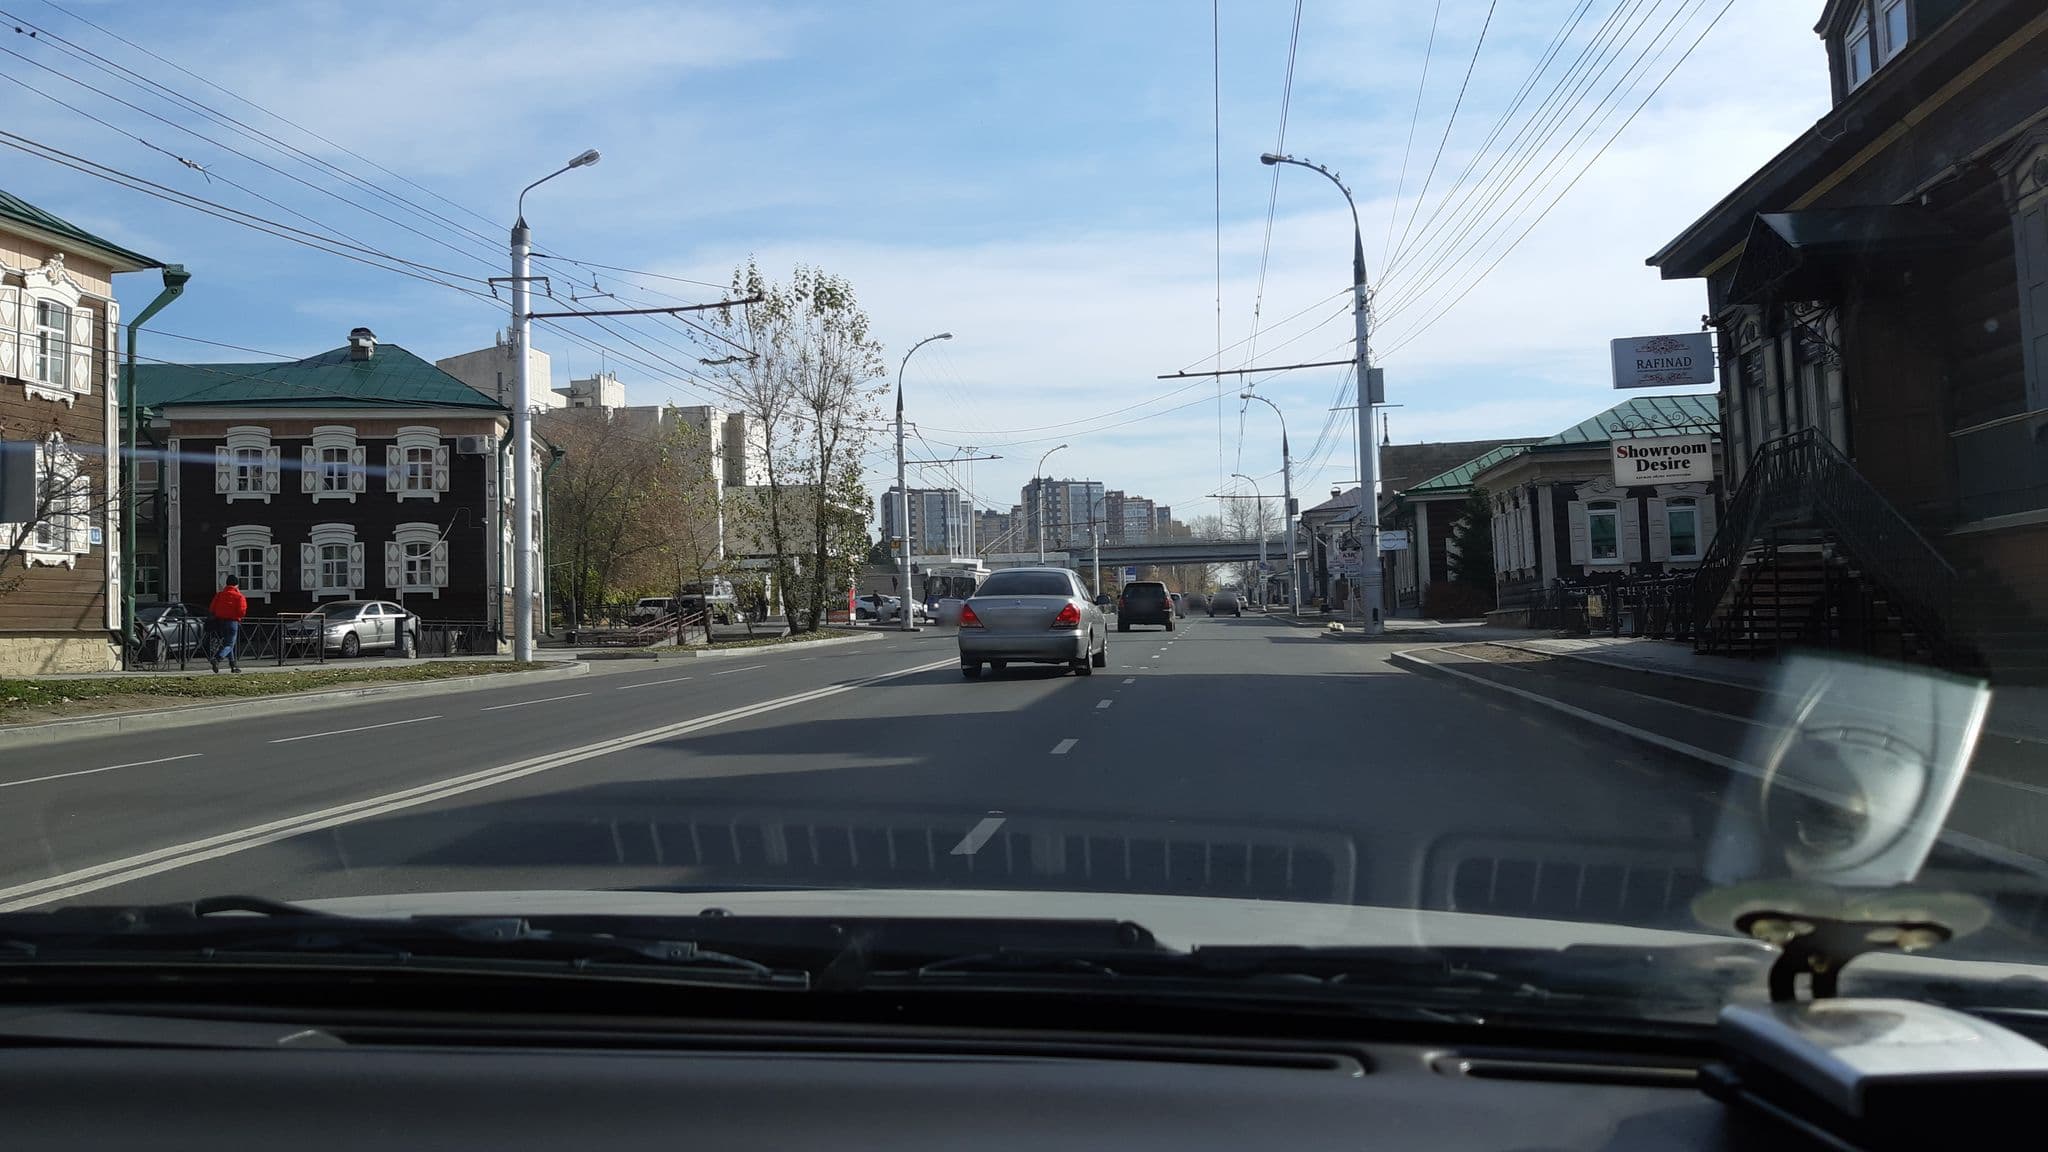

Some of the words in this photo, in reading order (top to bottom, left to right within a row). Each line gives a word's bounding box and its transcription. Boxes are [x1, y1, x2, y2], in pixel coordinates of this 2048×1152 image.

[1636, 356, 1692, 370] RAFINAD
[1616, 442, 1707, 459] Showroom
[1636, 457, 1691, 472] Desire
